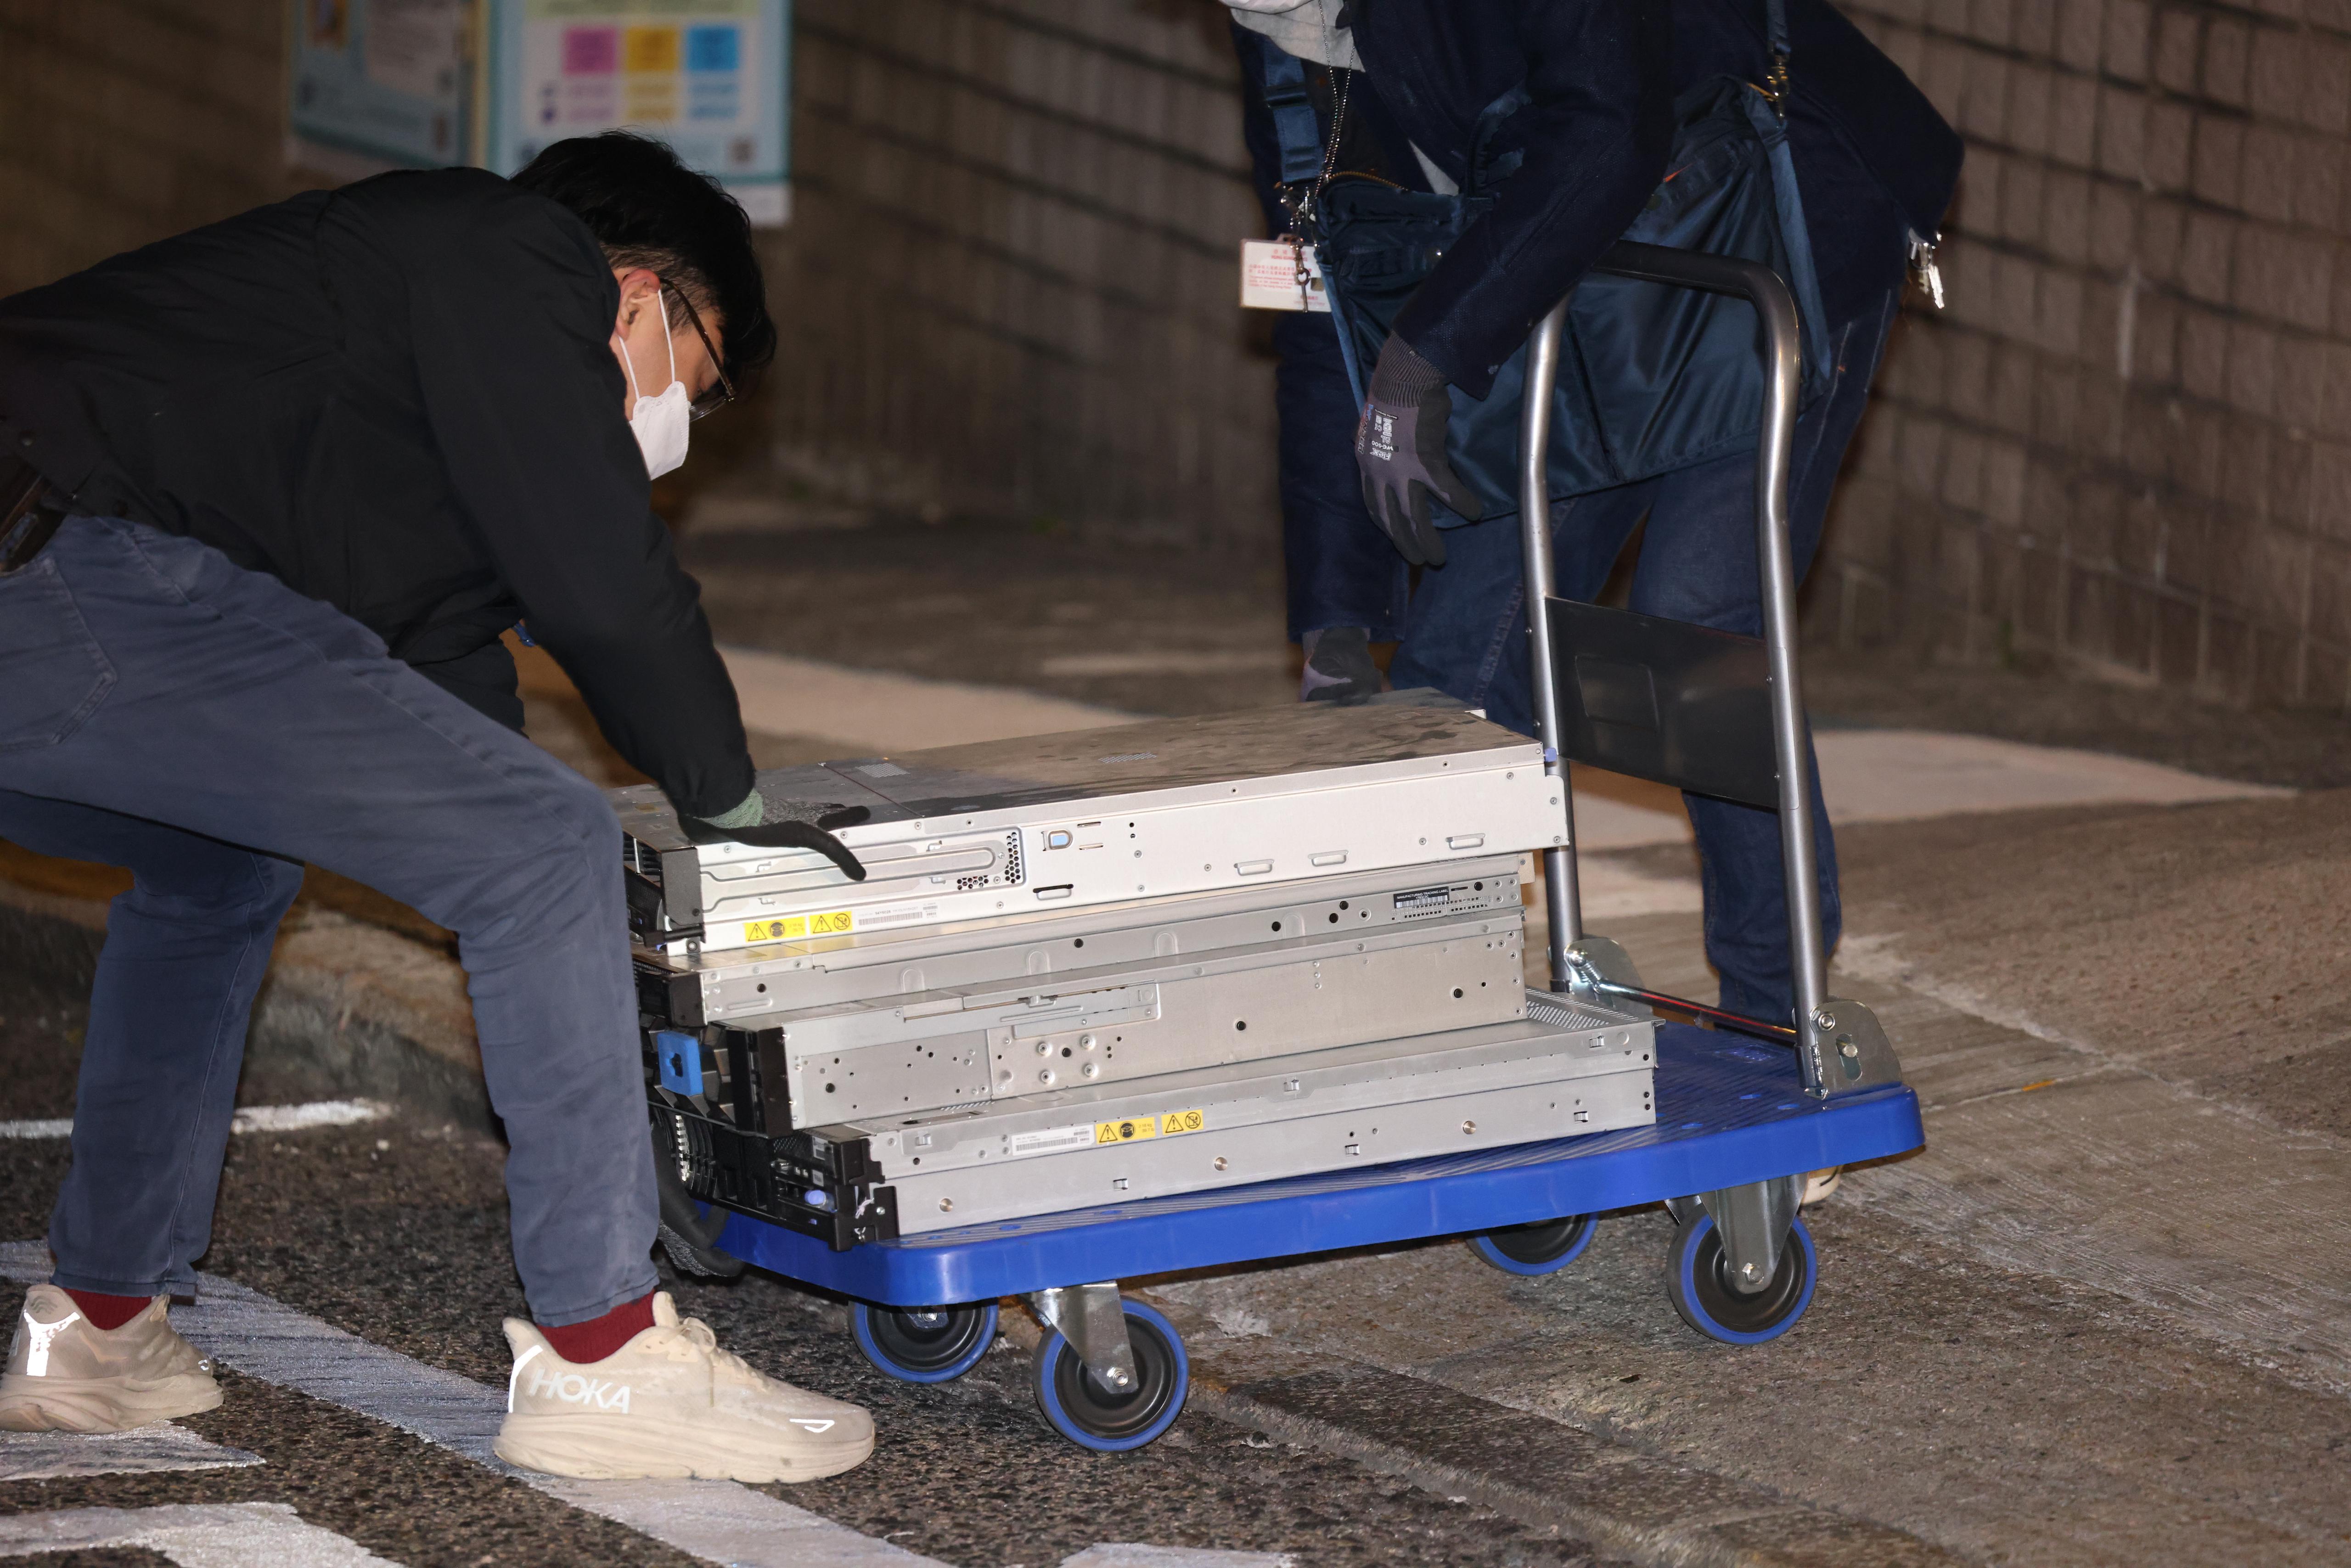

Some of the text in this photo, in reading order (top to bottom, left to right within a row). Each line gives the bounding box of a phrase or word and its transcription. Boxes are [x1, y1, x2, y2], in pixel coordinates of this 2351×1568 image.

[1372, 441, 1394, 451] WG-500
[1370, 447, 1392, 461] Flex
[528, 1367, 631, 1414] HOKA
